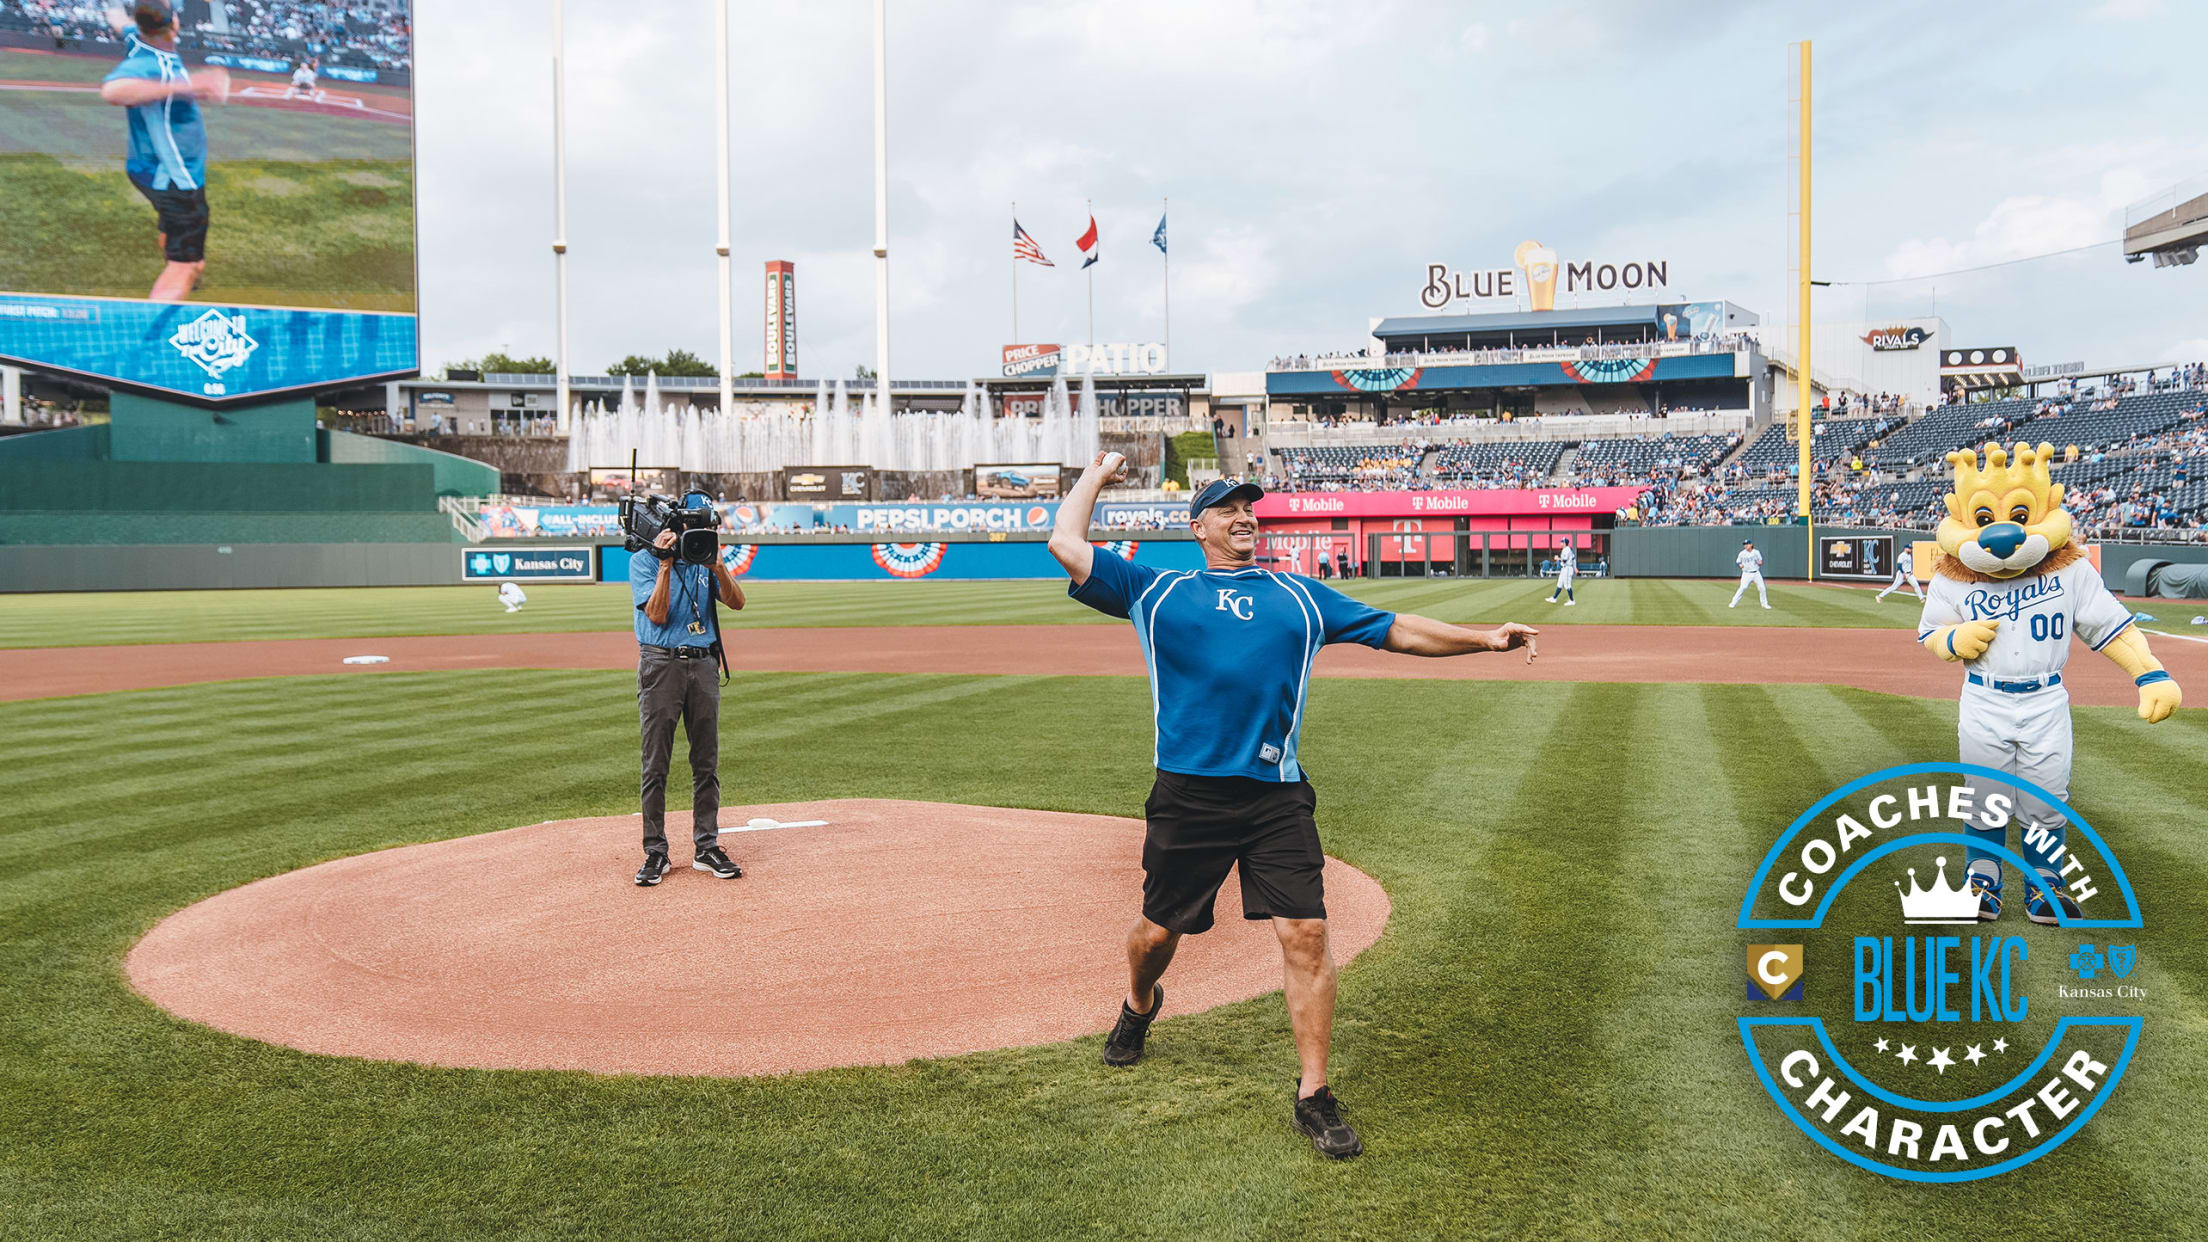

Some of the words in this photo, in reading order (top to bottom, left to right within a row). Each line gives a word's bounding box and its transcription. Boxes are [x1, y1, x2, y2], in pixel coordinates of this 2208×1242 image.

[1421, 264, 1514, 310] BLUE
[1567, 261, 1668, 292] MOON
[767, 280, 778, 365] BOULEVARD
[784, 280, 796, 365] BOULEVARD
[1873, 333, 1920, 347] RIVALS
[1005, 345, 1040, 361] PRICE
[1067, 343, 1166, 374] PATIO
[1004, 354, 1059, 376] CHOPPER
[1100, 397, 1182, 417] HOPPER
[1303, 497, 1344, 511] Mobile
[1426, 496, 1469, 510] Mobile
[1553, 494, 1597, 508] Mobile
[857, 508, 928, 529] PEPSI
[933, 508, 1022, 528] PORCH
[1266, 530, 1333, 551] Mobile
[514, 557, 558, 571] Kansas
[559, 557, 584, 572] City
[1216, 588, 1254, 621] KC
[1964, 573, 2065, 621] Royals
[2030, 612, 2064, 642] 00
